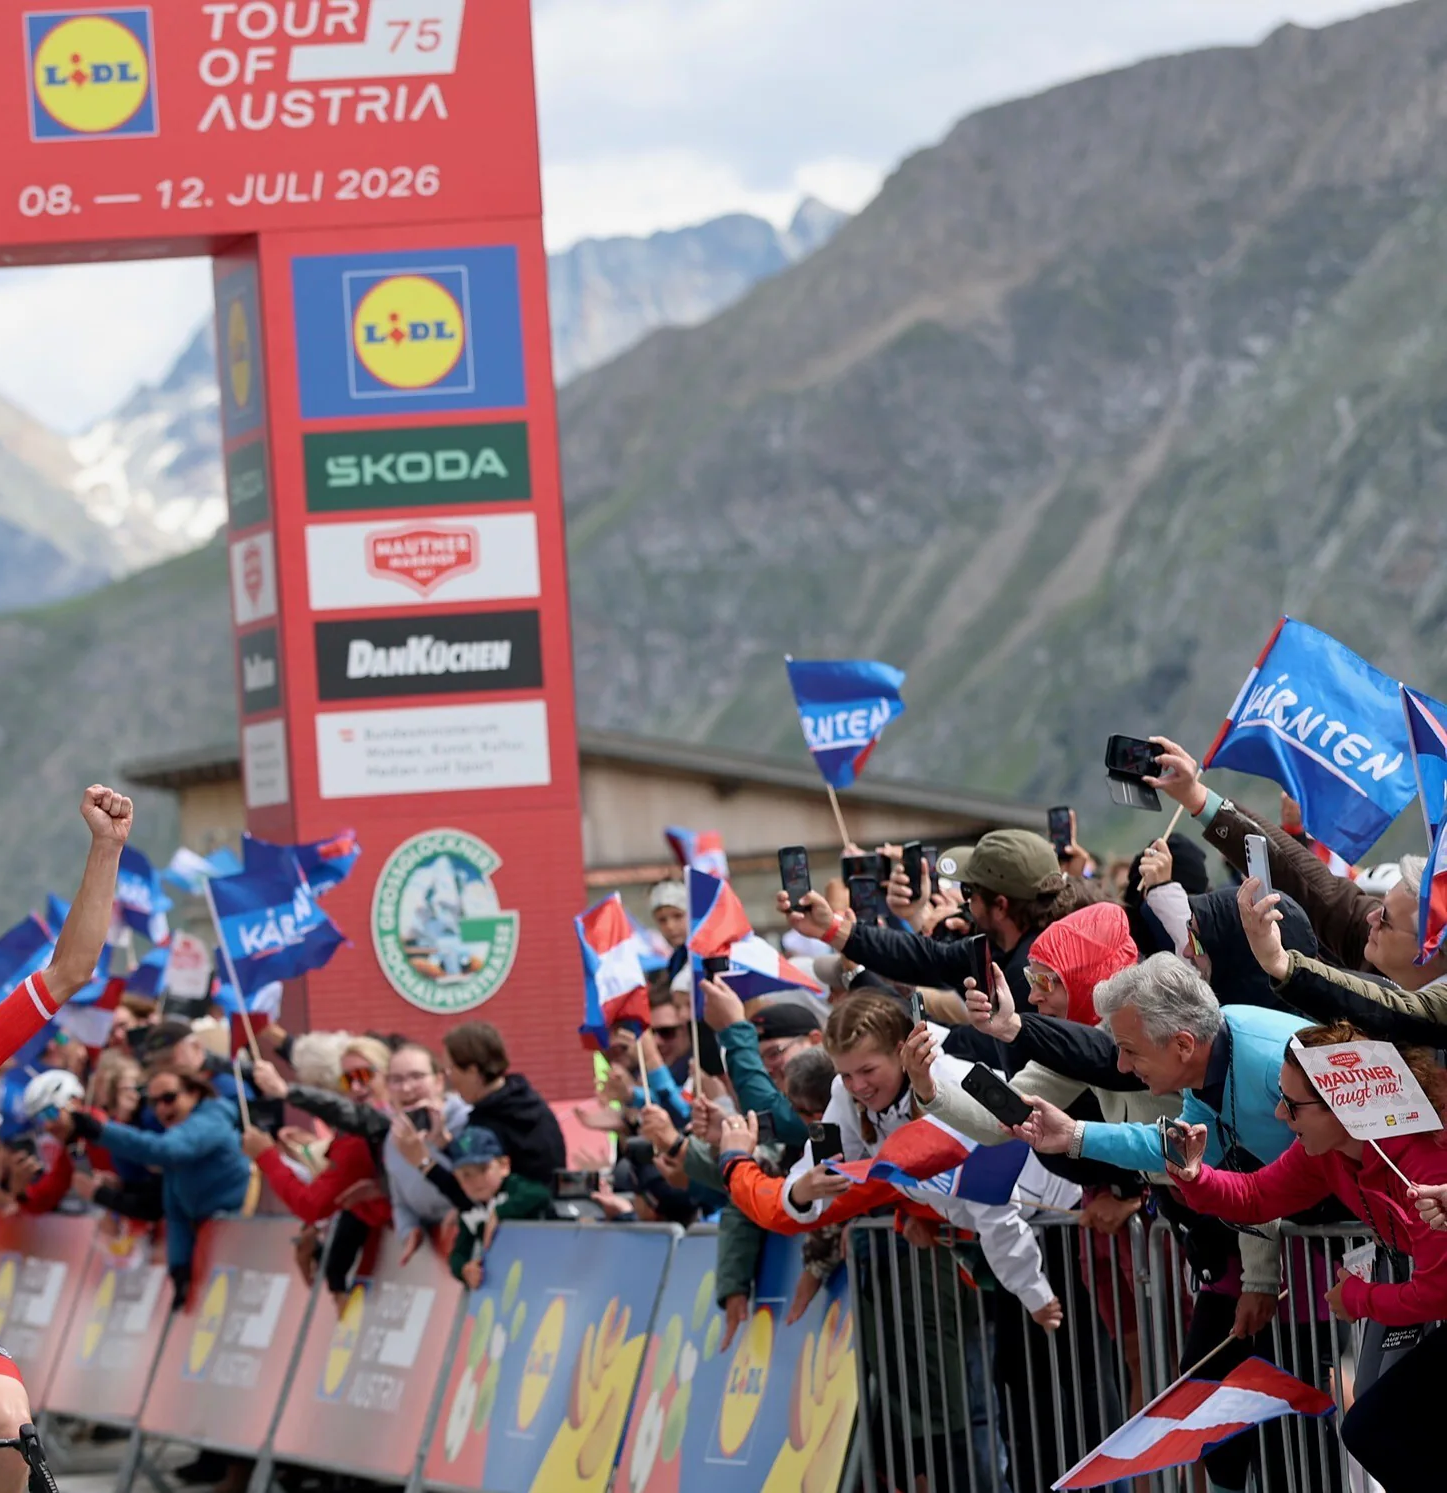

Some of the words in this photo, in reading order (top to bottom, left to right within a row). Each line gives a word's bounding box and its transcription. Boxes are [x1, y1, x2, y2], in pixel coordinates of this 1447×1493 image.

[201, 0, 359, 41] TOUR
[385, 18, 444, 54] 75
[198, 46, 276, 87] OF
[198, 83, 449, 133] AUSTRIA
[18, 183, 82, 217] 08.
[156, 178, 214, 209] 12.
[226, 171, 324, 206] JULI
[334, 165, 441, 200] 2026
[325, 448, 509, 488] SKODA
[1314, 1065, 1397, 1090] MAUTNER
[1325, 1081, 1372, 1108] Taugt
[1375, 1073, 1404, 1097] ma!
